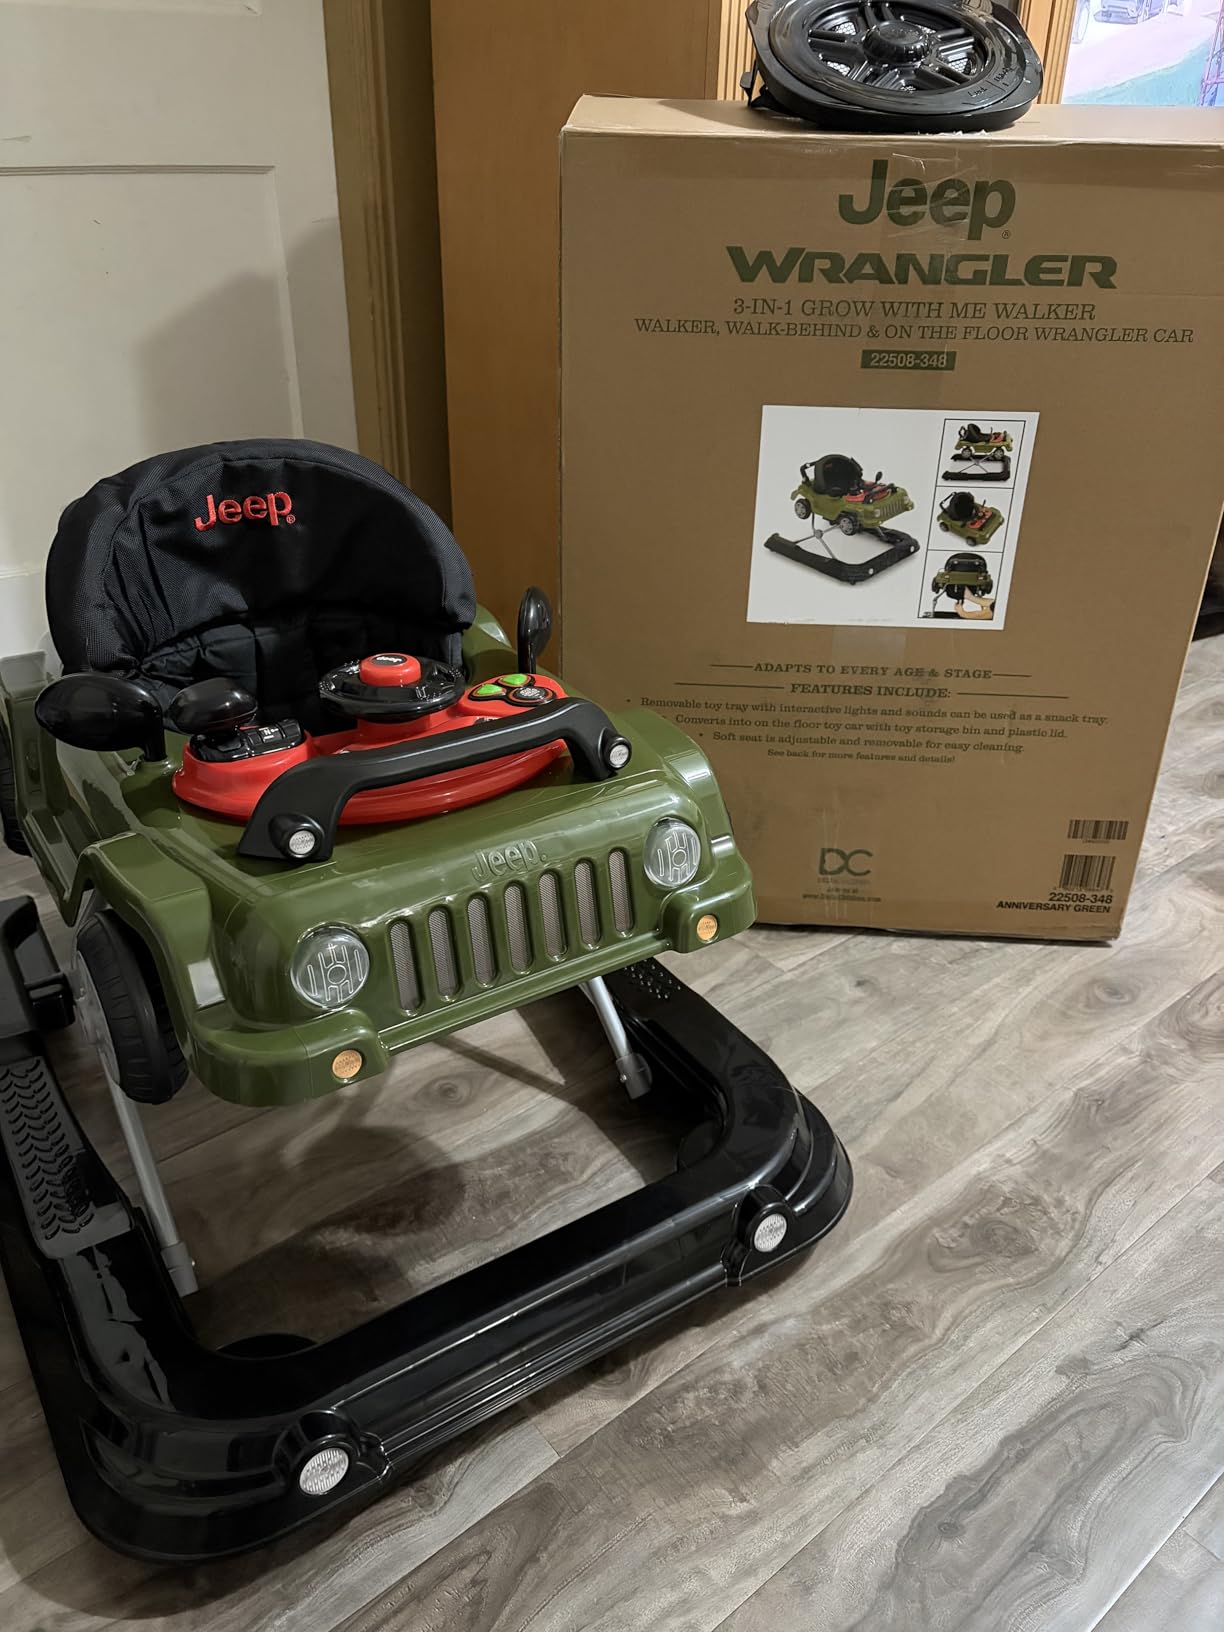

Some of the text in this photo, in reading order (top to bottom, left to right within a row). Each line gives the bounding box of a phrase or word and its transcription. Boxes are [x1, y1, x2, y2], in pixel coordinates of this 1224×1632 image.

[838, 159, 1015, 240] Jeep
[726, 245, 1118, 289] WRANGLER
[733, 298, 1096, 321] 3-IN-1 GROW WITH ME WALKER
[634, 318, 1194, 343] WALKER, WALK-BEHIND & ON THE FLOOR WRANGLER CAR
[870, 353, 947, 368] 22508-348
[194, 491, 292, 532] Jeep
[753, 662, 993, 679] ADAPTS TO EVERY AGE & STAGE
[790, 683, 952, 698] FEATURES INCLUDE:
[640, 697, 701, 709] Removable
[704, 701, 722, 711] toy
[725, 701, 749, 713] tray
[751, 702, 776, 712] with
[780, 703, 841, 715] interactive
[844, 704, 878, 717] lights
[880, 707, 903, 717] and
[904, 708, 948, 718] sounds
[950, 710, 971, 719] can
[973, 710, 988, 719] be
[990, 710, 1016, 720] used
[1019, 712, 1033, 721] as
[1035, 713, 1042, 721] a
[1044, 712, 1079, 722] snack
[675, 714, 726, 726] Converts
[728, 716, 752, 726] into
[754, 719, 769, 727] on
[772, 718, 791, 728] the
[794, 719, 822, 729] floor
[823, 721, 842, 732] toy
[844, 722, 863, 731] car
[865, 722, 892, 731] with
[894, 723, 913, 733] toy
[915, 724, 959, 736] storage
[962, 725, 980, 735] bin
[983, 726, 1005, 736] and
[1007, 727, 1047, 738] plastic
[712, 731, 737, 741] Soft
[739, 733, 763, 742] seat
[765, 734, 775, 743] is
[778, 734, 836, 746] adjustable
[838, 736, 861, 746] and
[863, 738, 923, 749] removable
[926, 740, 942, 749] for
[944, 742, 970, 752] easy
[767, 749, 785, 757] See
[786, 749, 809, 758] back
[812, 750, 826, 759] for
[828, 752, 853, 760] more
[856, 752, 896, 762] features
[898, 754, 916, 762] and
[471, 840, 540, 882] Jeep
[819, 847, 873, 876] DC
[996, 900, 1111, 913] ANNIVERSARY GREEN
[1049, 892, 1113, 904] 22508-348
